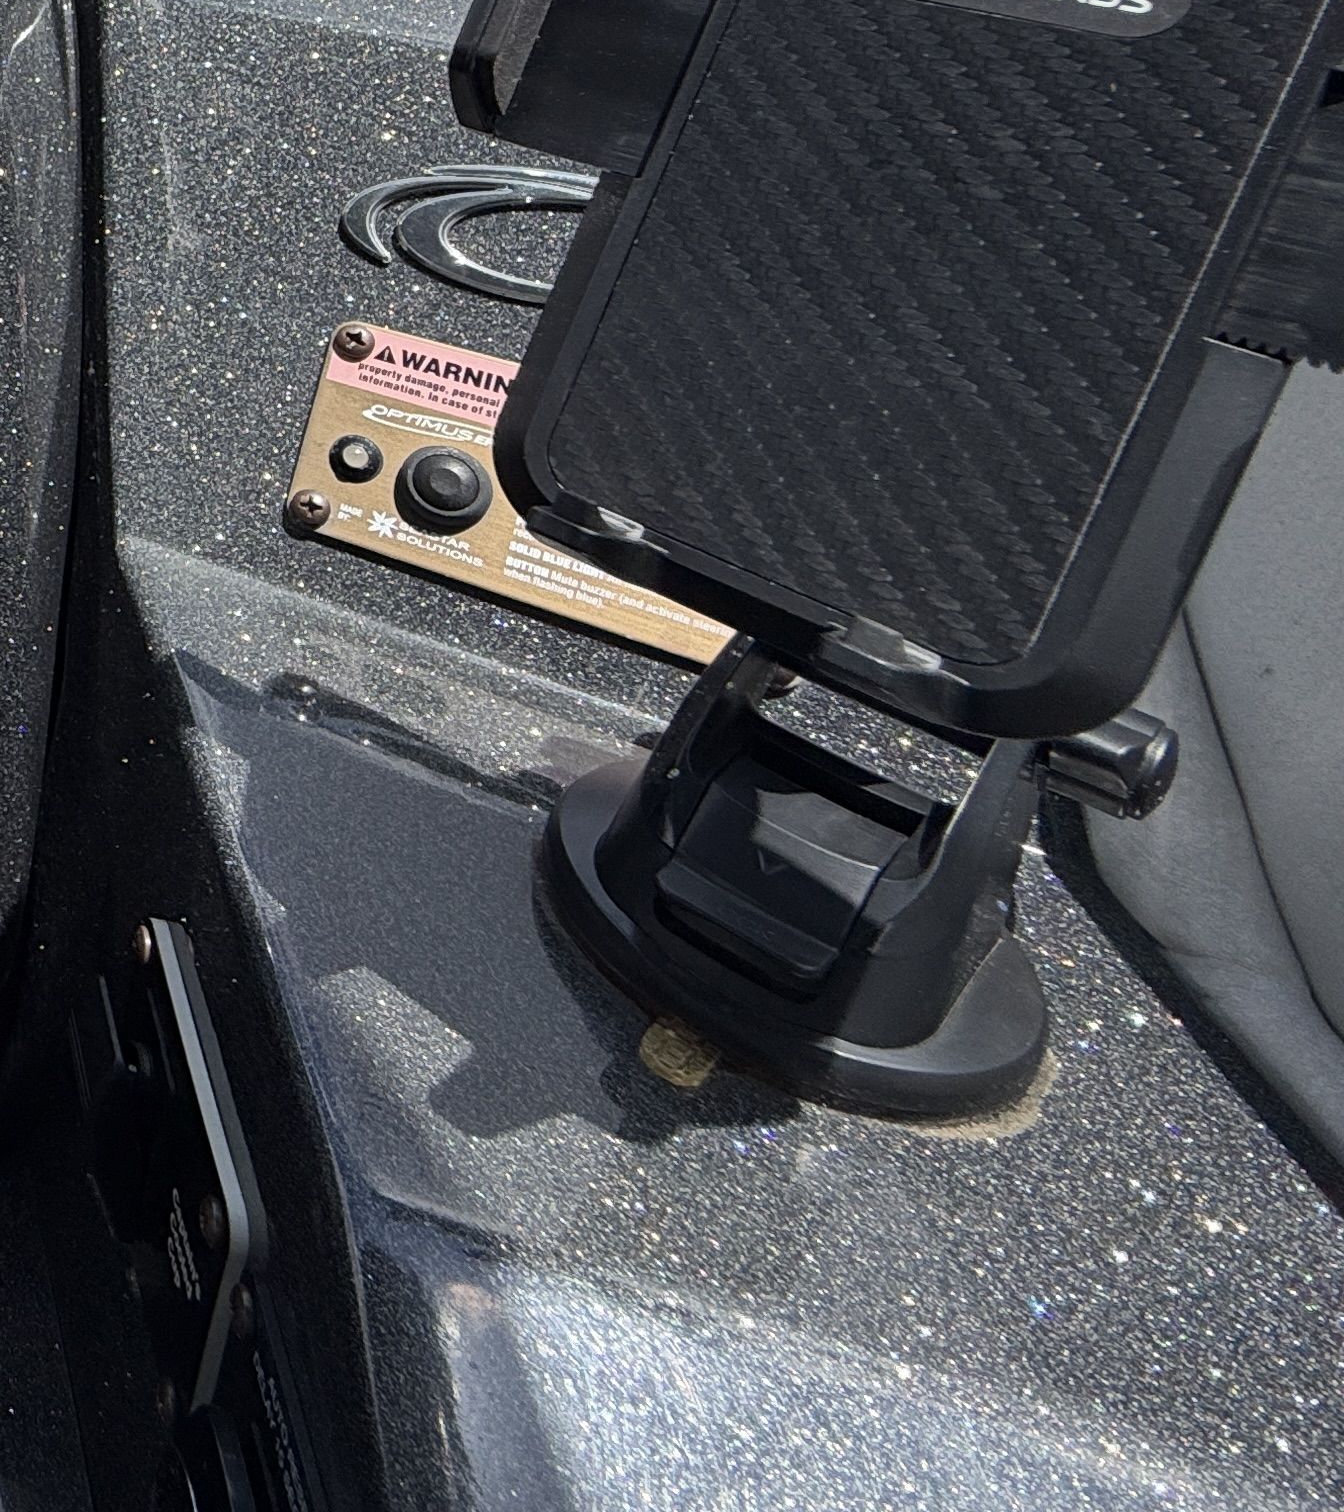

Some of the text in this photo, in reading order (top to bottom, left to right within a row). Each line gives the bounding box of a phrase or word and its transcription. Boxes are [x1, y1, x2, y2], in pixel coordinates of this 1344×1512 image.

[358, 363, 501, 407] property damage, personal
[402, 349, 512, 395] WARNIN
[359, 373, 424, 398] information.
[442, 398, 468, 410] case
[472, 406, 483, 414] of
[369, 404, 475, 441] OPTIMUS
[397, 532, 484, 568] SOLUTIONS
[509, 541, 541, 559] SOLID
[543, 551, 571, 569] BLUE
[504, 568, 531, 583] when
[533, 576, 574, 599] flashing
[505, 556, 549, 577] BUTTON
[551, 570, 579, 588] Mute
[581, 577, 616, 599] buzzer
[620, 593, 644, 610] (and
[646, 601, 690, 624] activate
[693, 618, 736, 637] steerin
